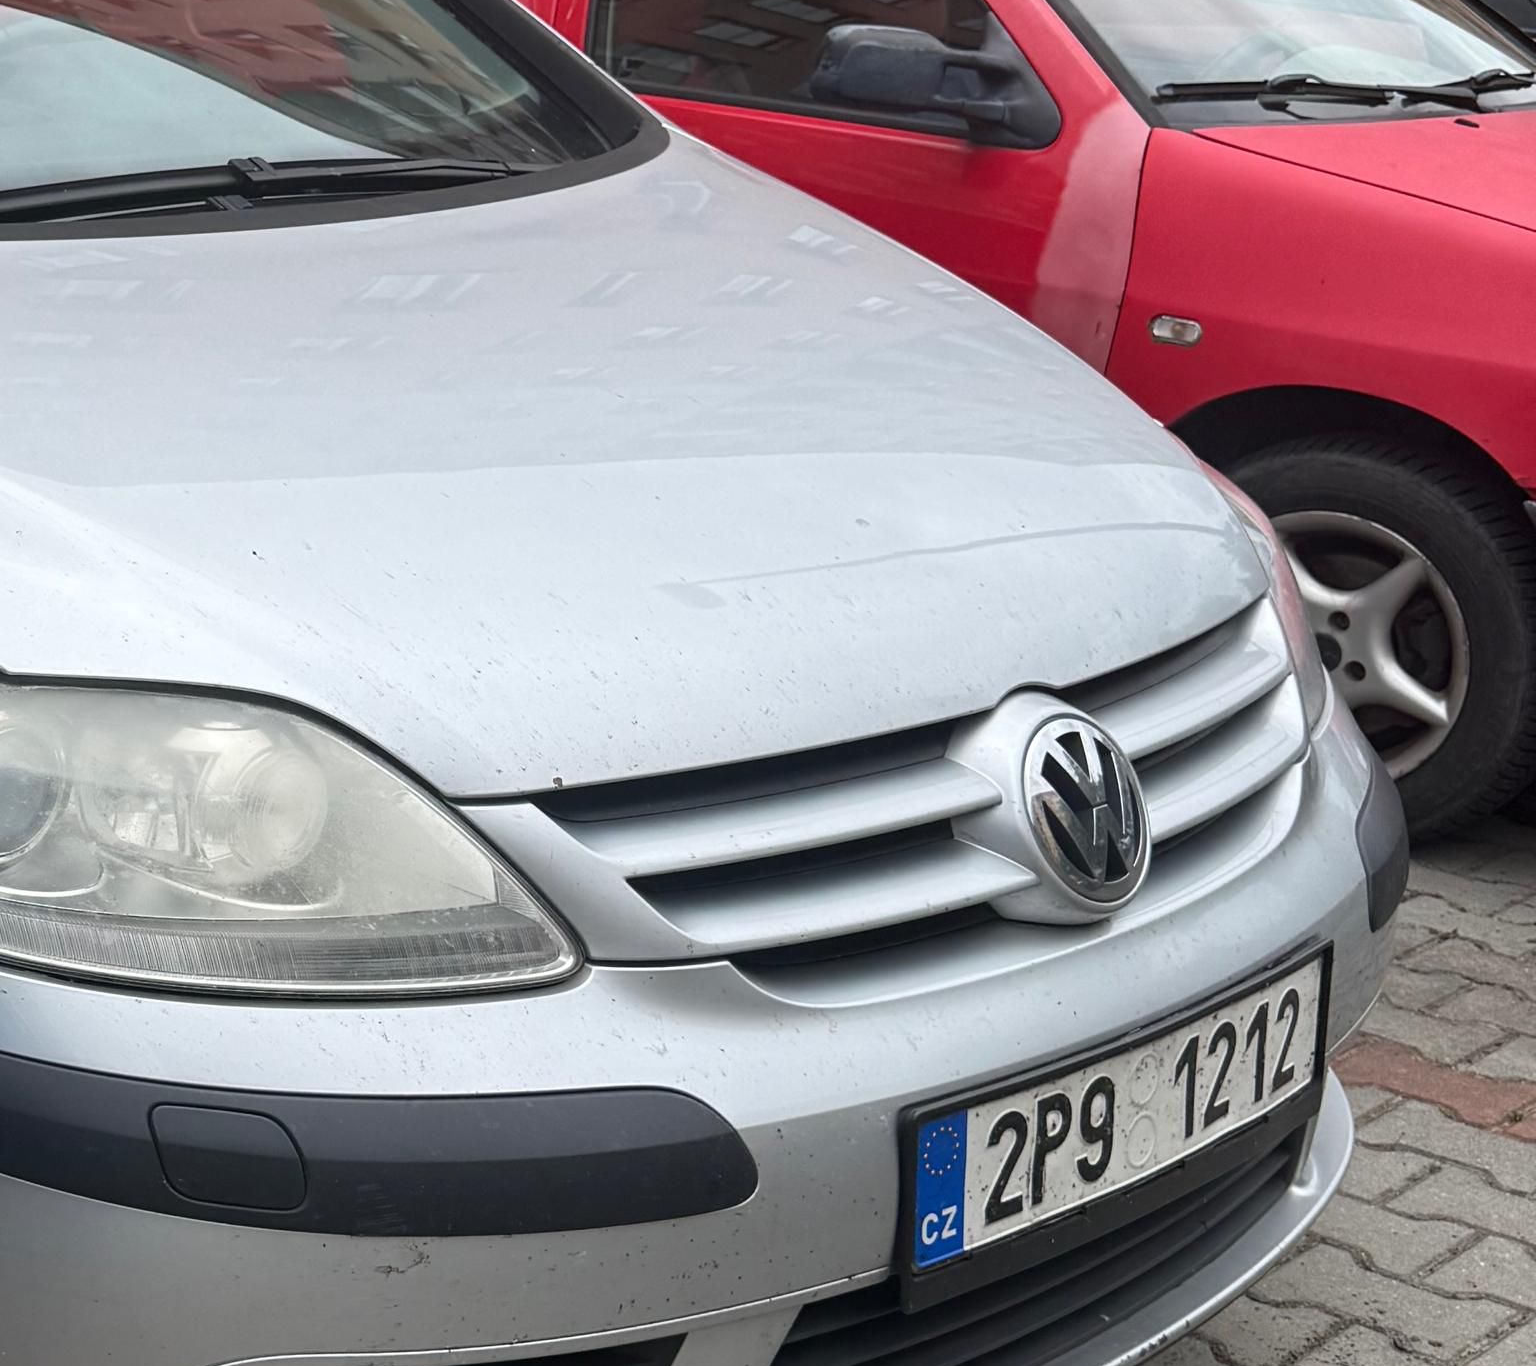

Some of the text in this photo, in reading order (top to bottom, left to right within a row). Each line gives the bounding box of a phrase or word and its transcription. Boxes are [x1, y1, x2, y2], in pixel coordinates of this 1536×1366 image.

[984, 986, 1301, 1225] 2P9 1212
[921, 1205, 958, 1246] CZ
